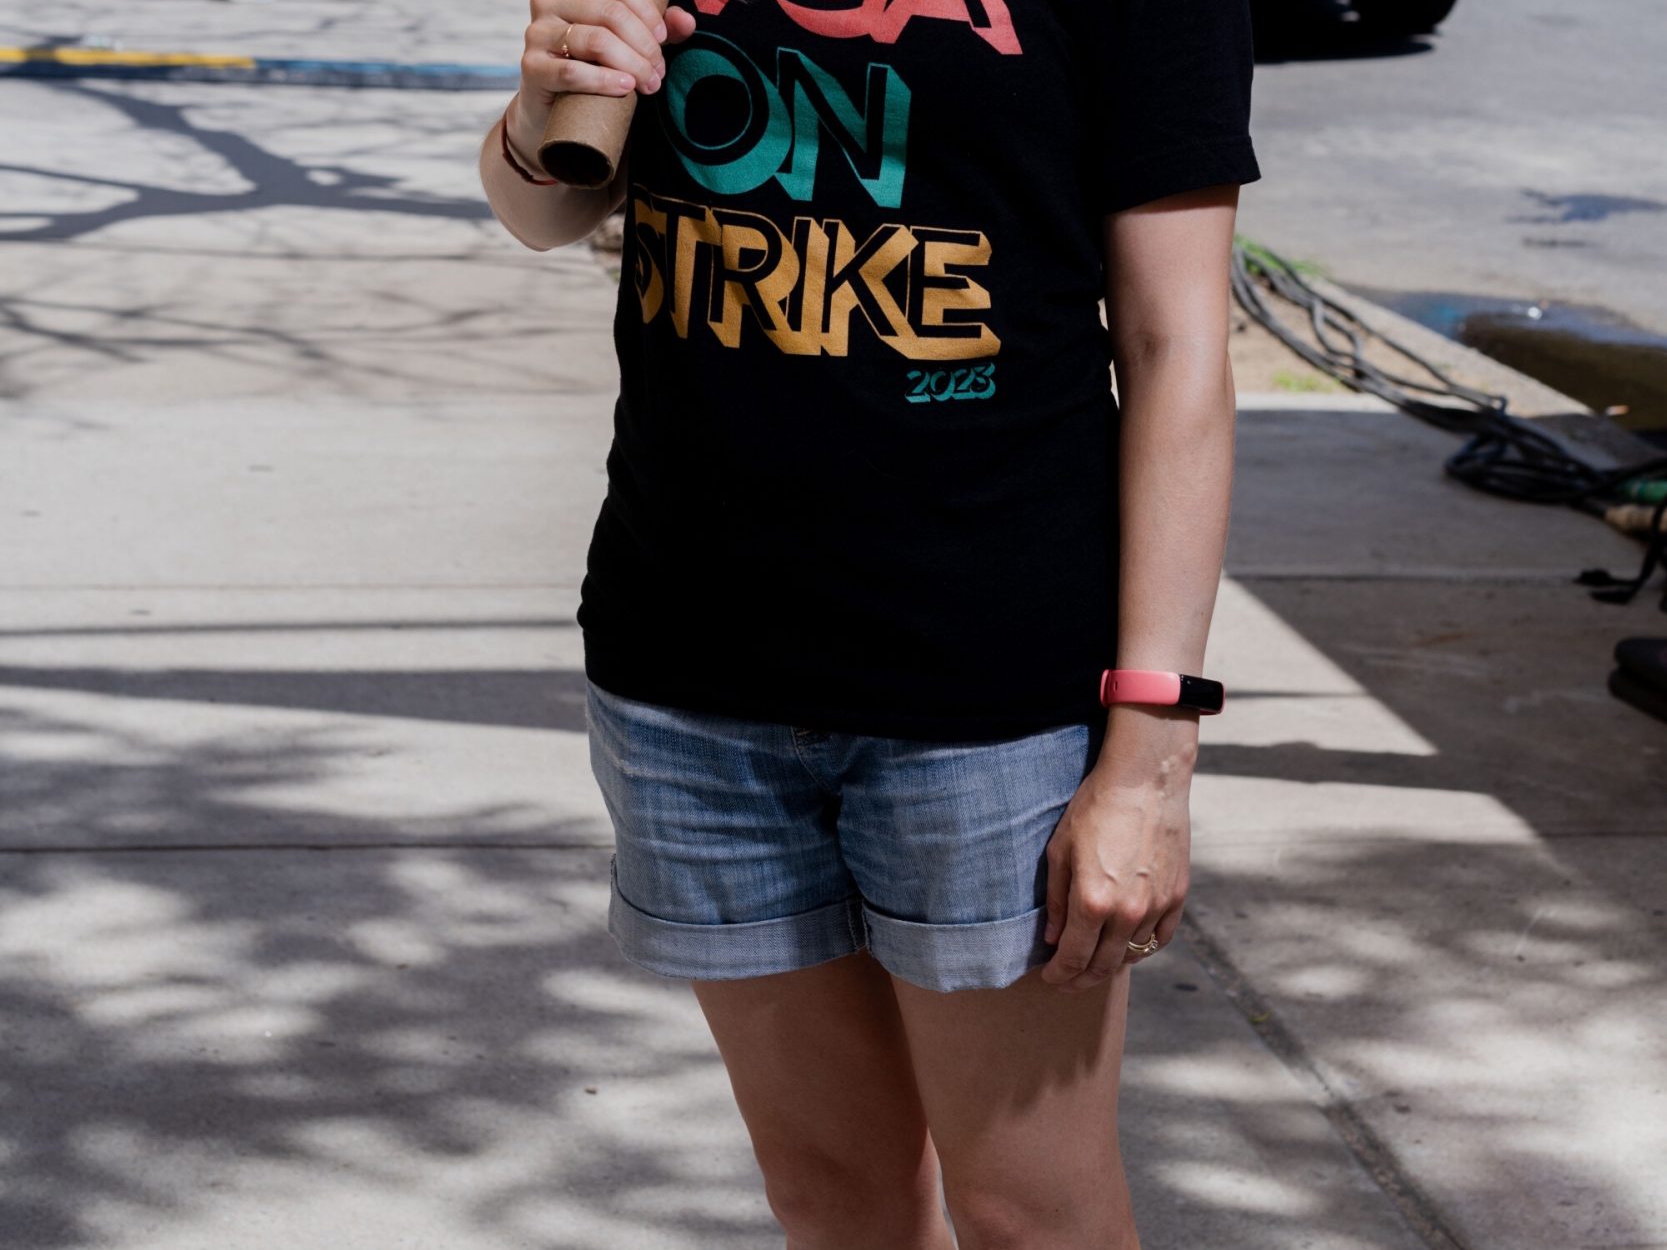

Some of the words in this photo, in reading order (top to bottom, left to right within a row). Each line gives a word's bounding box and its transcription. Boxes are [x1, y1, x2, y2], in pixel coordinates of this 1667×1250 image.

[655, 30, 912, 209] ON
[633, 182, 1002, 361] STRIKE
[904, 361, 997, 404] 2023
